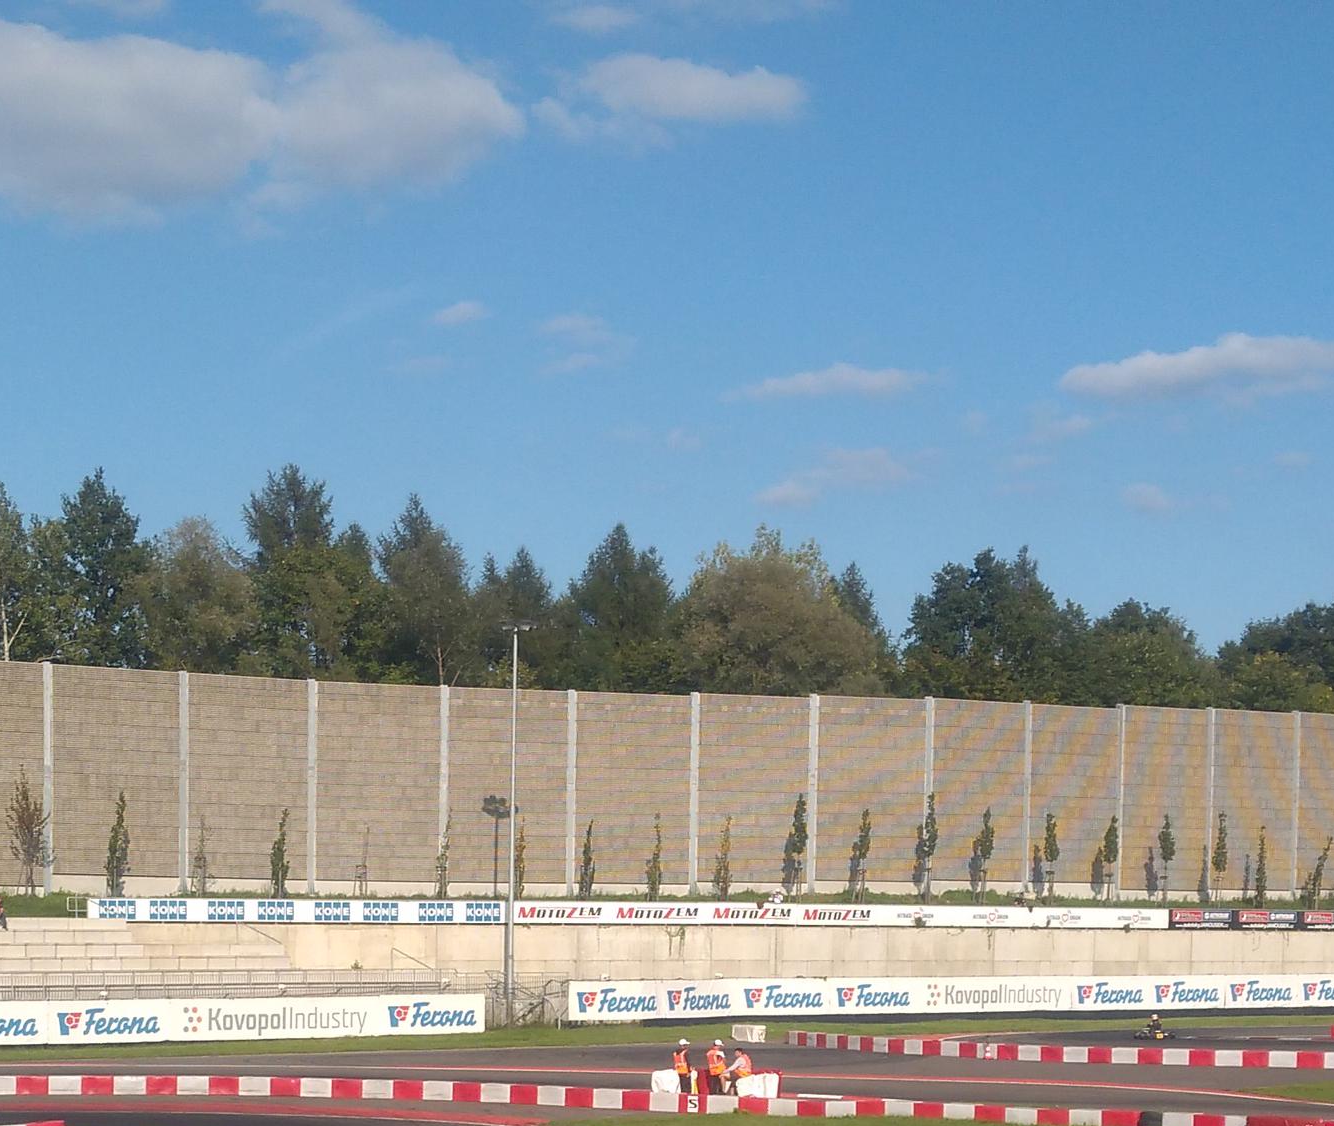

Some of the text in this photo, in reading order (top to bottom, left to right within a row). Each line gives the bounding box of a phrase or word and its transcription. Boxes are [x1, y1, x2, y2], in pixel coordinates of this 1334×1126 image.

[100, 904, 136, 916] KONE
[150, 904, 187, 916] KONE
[208, 905, 244, 916] KONE
[258, 905, 294, 917] KONE
[315, 906, 350, 917] KONE
[364, 906, 398, 918] KONE
[419, 906, 453, 918] KONE
[467, 907, 501, 918] KONE
[598, 988, 657, 1012] Ferona
[679, 986, 731, 1010] Ferona
[764, 984, 823, 1008] Ferona
[851, 983, 911, 1007] Ferona
[1091, 981, 1143, 1004] Ferona
[1169, 981, 1221, 1003] Ferona
[1242, 980, 1293, 1002] Ferona
[83, 1007, 161, 1035] Ferona
[409, 1001, 477, 1028] Ferona
